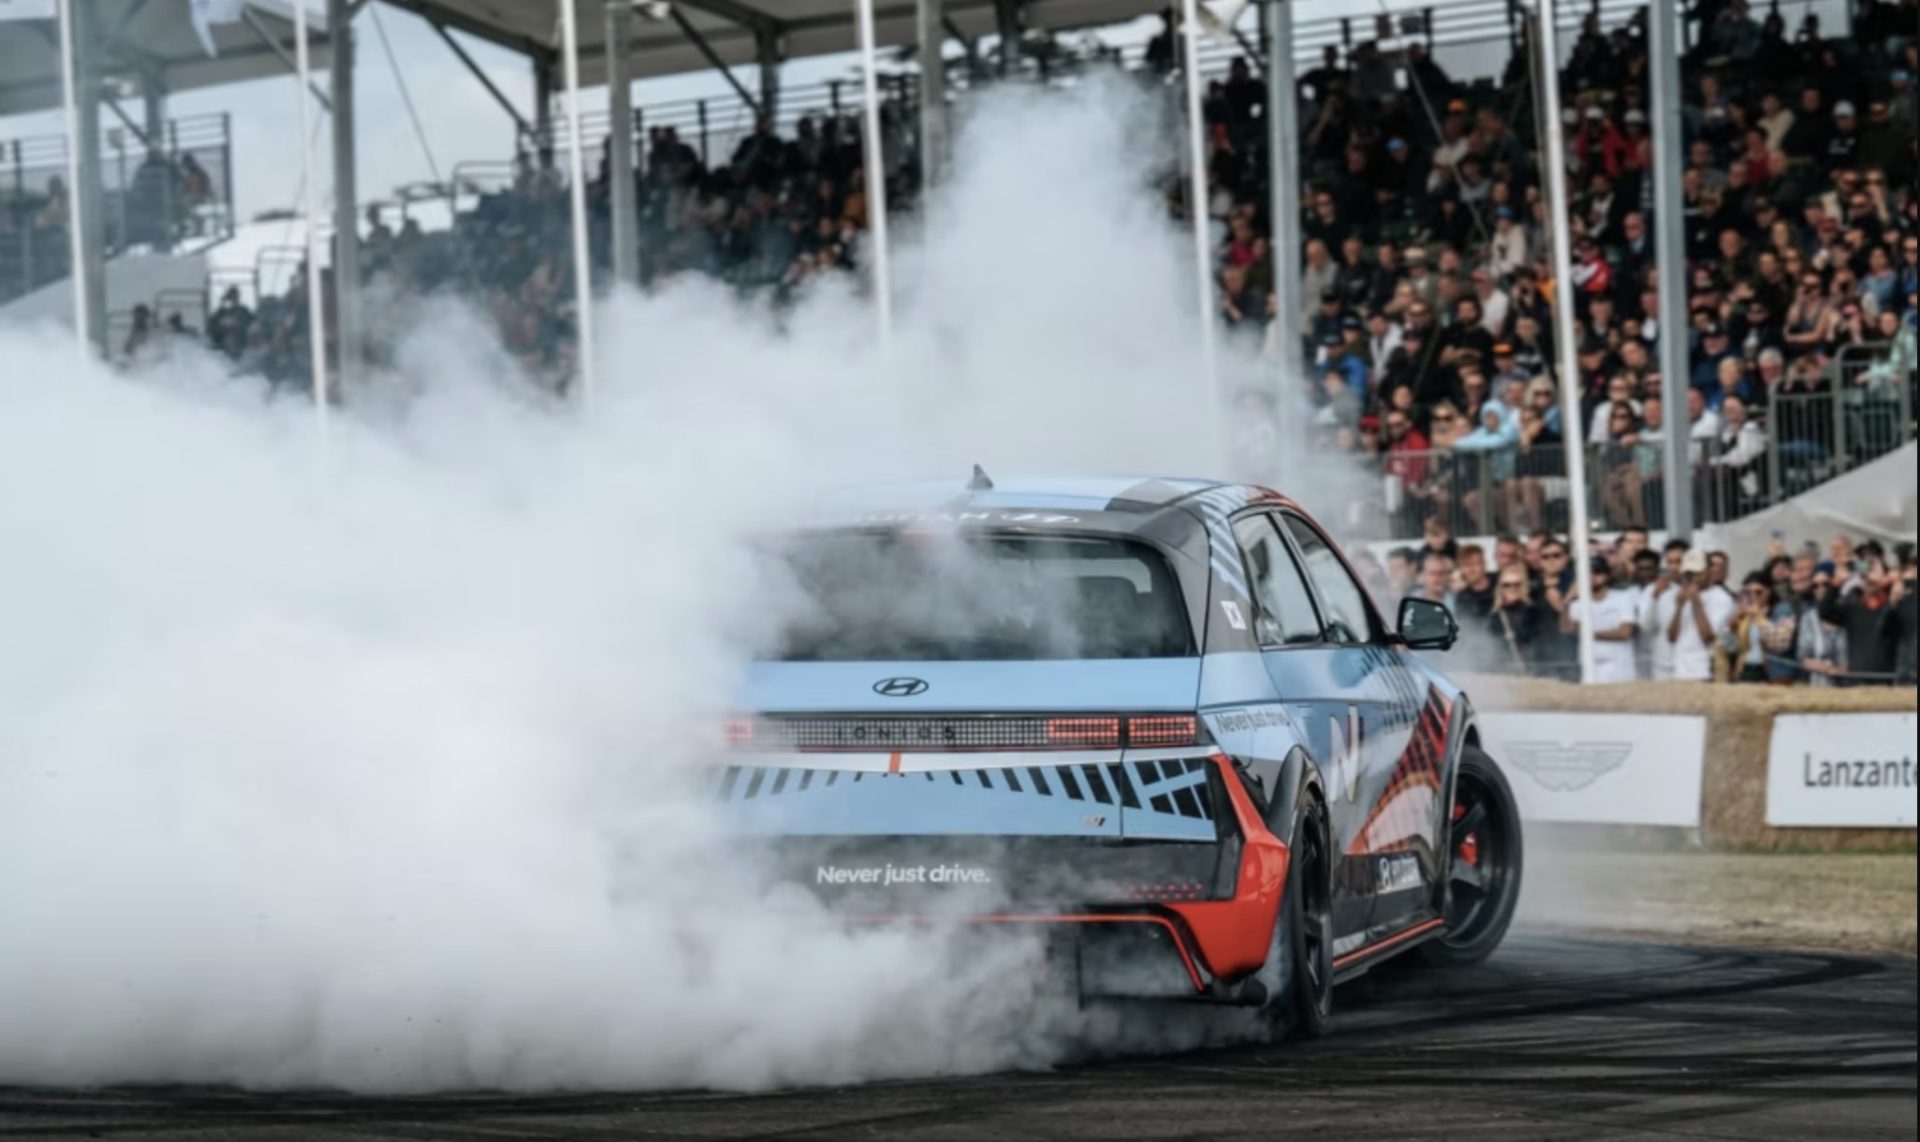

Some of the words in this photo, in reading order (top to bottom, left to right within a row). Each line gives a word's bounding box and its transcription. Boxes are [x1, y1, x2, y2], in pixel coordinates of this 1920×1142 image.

[816, 866, 882, 884] Never
[884, 863, 927, 886] just
[929, 864, 991, 883] drive.
